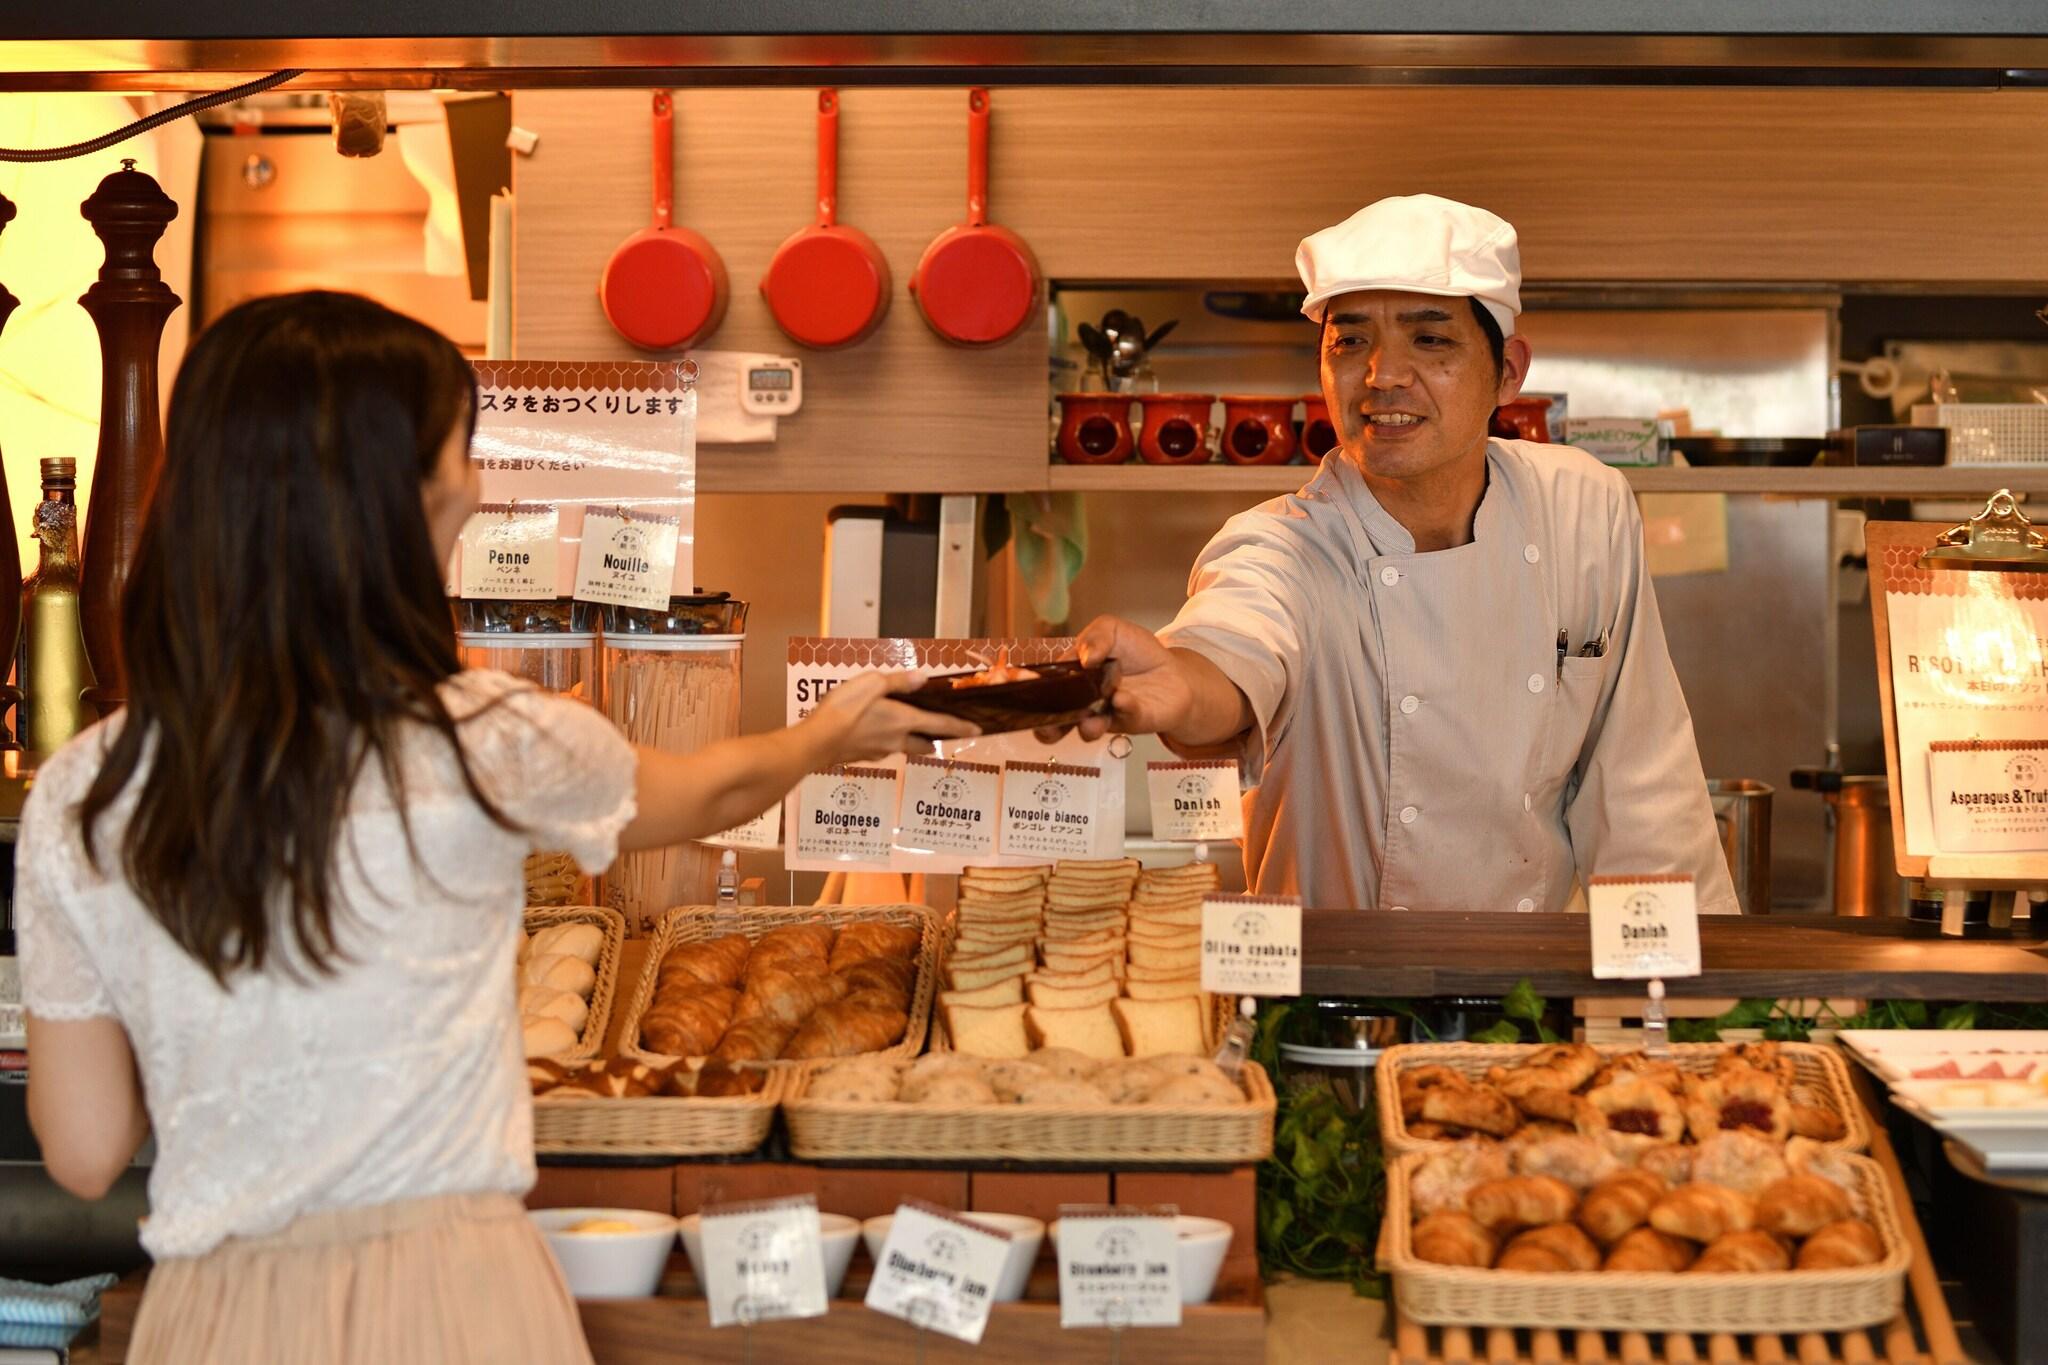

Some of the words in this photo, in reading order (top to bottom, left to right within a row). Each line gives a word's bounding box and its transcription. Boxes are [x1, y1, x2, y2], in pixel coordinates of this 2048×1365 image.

[480, 394, 683, 415] スタをおつくりします
[488, 549, 530, 565] Penne
[603, 553, 649, 573] Nouille
[612, 571, 636, 581] ヌイユ
[1174, 798, 1220, 810] Danish
[1950, 791, 2009, 805] Asparagus
[815, 810, 880, 827] Bolognese
[916, 800, 981, 822] Carbonara
[1008, 806, 1050, 821] Vongole
[1055, 810, 1089, 825] bianco
[923, 818, 972, 830] カルボナーラ
[1621, 923, 1669, 939] Danish
